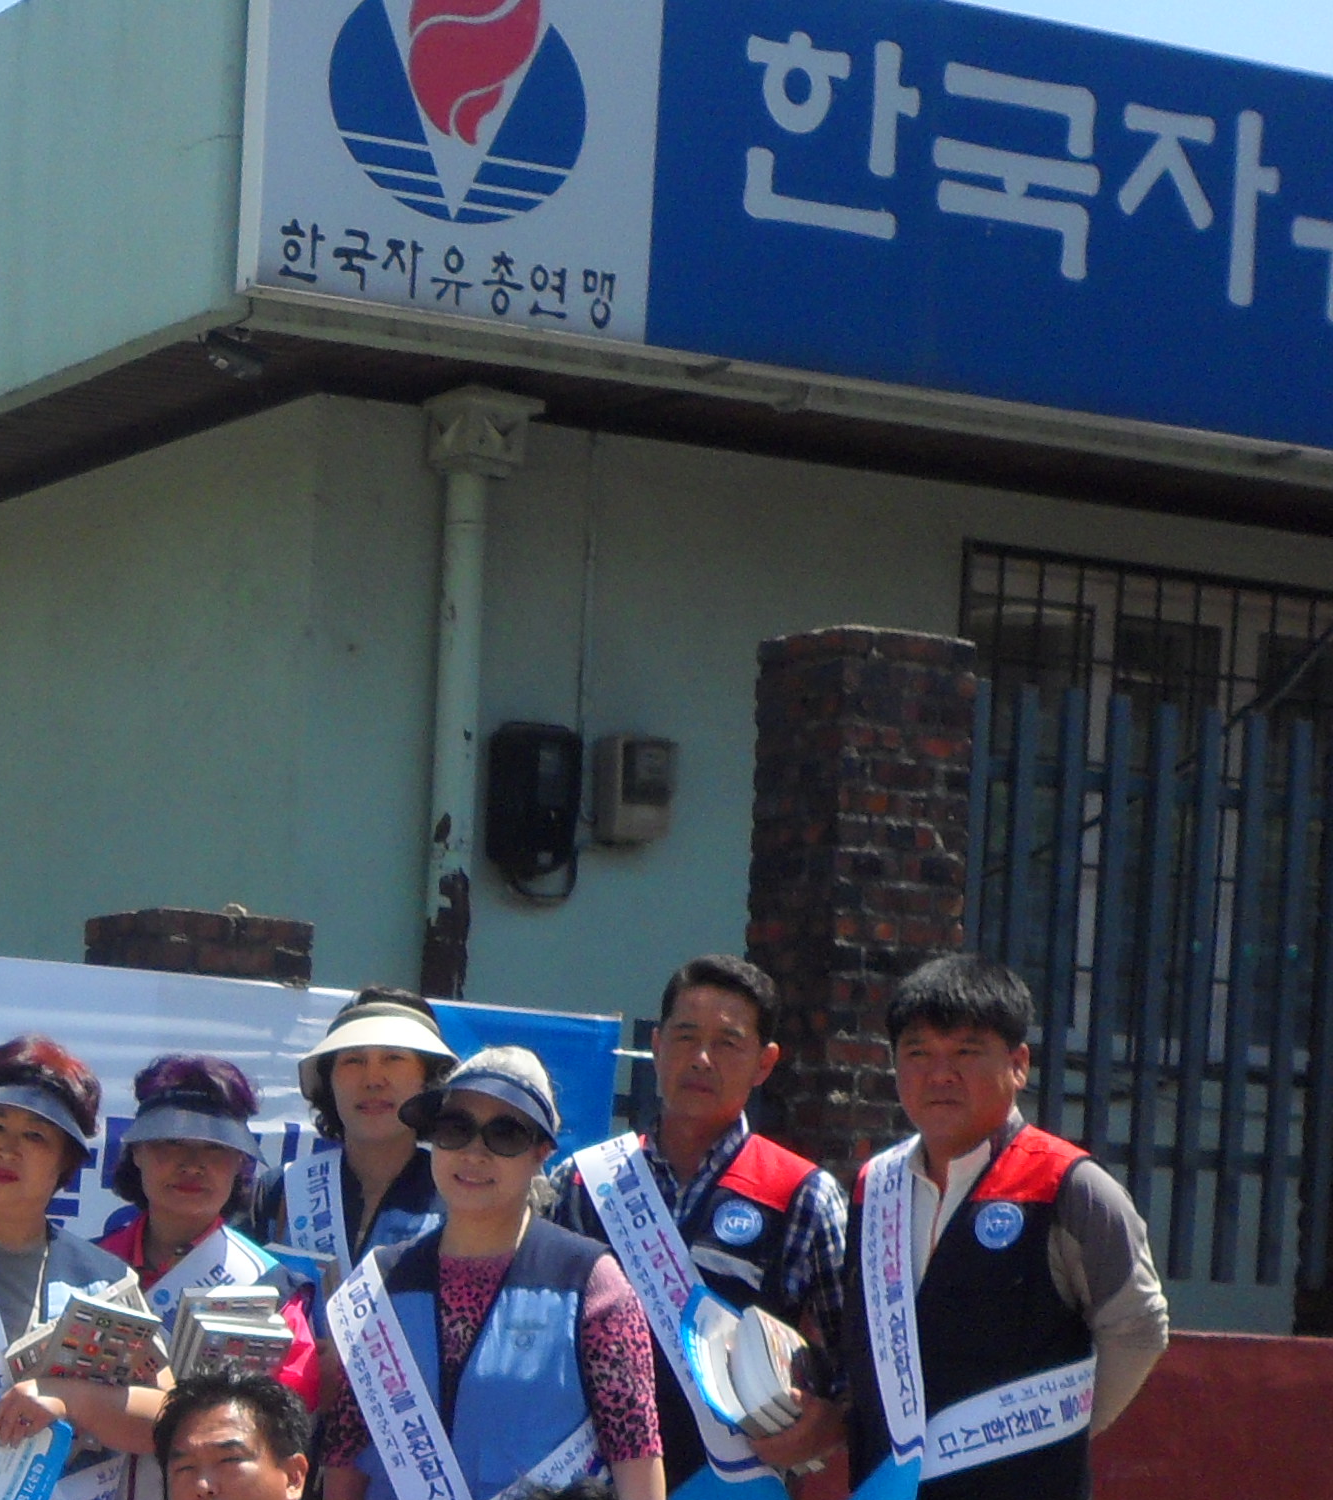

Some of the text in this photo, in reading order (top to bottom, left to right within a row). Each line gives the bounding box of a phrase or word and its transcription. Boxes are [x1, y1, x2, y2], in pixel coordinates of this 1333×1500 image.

[743, 29, 1333, 328] 한국자
[279, 219, 618, 332] 한국자유총연맹
[306, 1160, 332, 1233] 태극기를
[725, 1214, 753, 1232] KFF
[348, 1281, 378, 1320] 달아
[640, 1228, 692, 1309] 나라사랑
